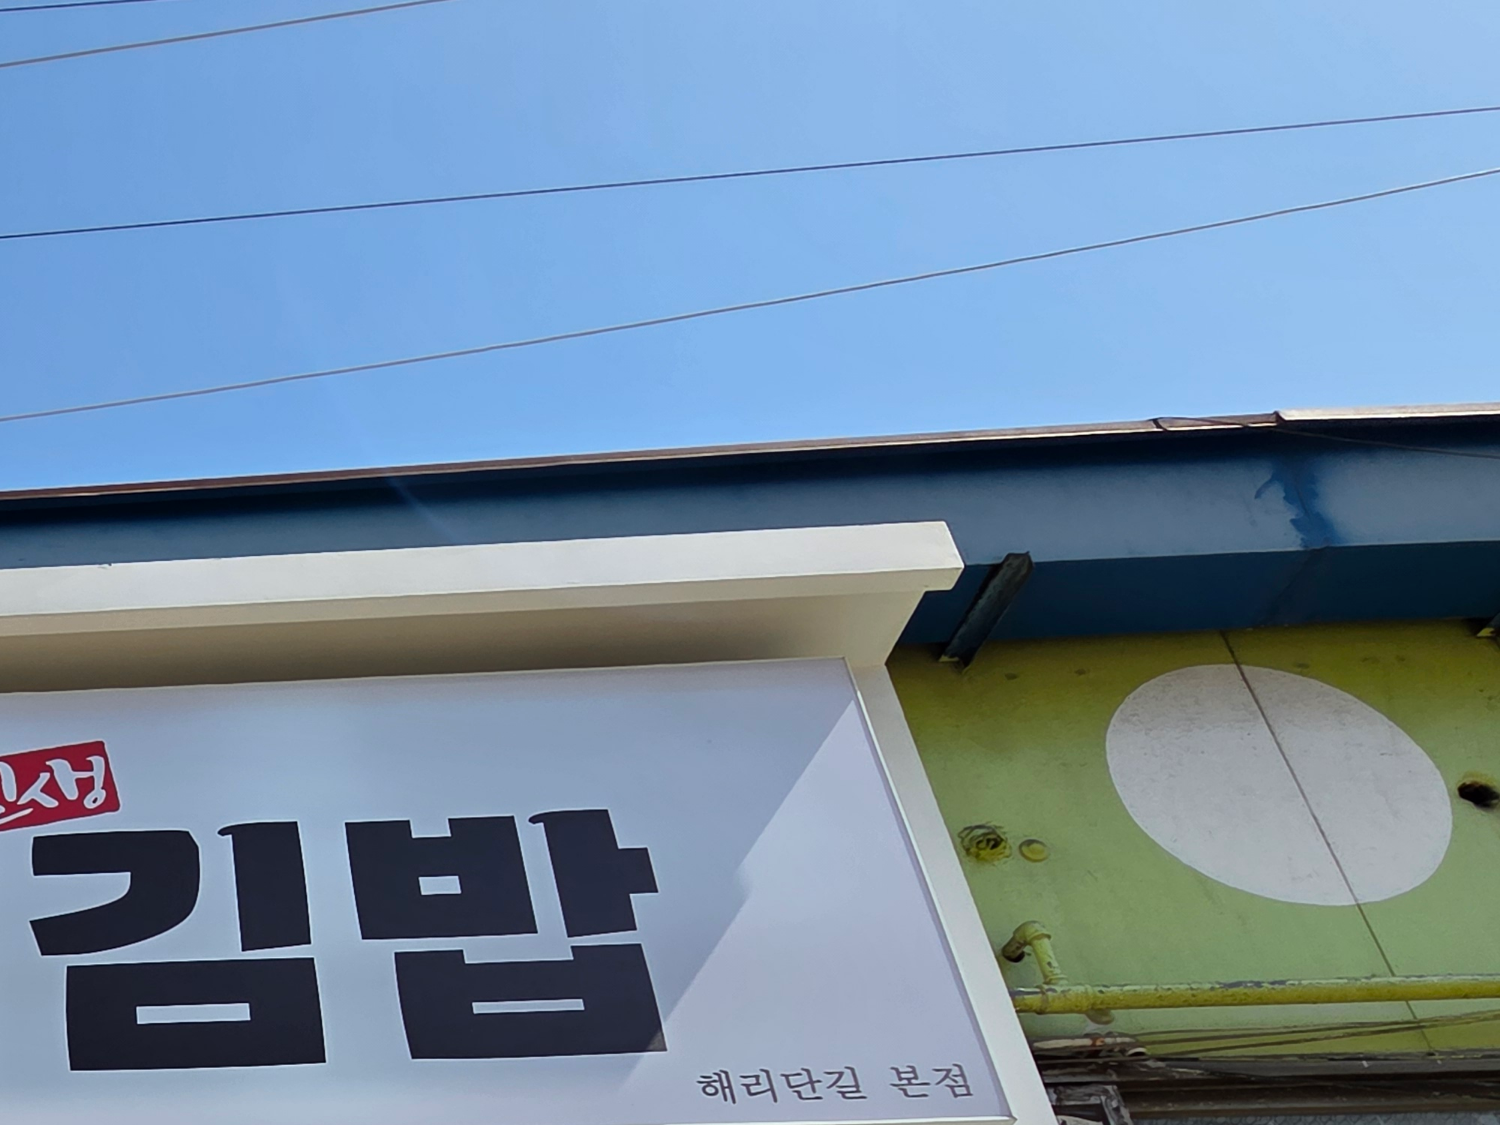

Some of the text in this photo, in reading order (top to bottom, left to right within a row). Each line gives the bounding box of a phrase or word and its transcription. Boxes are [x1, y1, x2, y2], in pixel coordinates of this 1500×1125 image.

[29, 808, 667, 1071] 김밥
[696, 1063, 973, 1104] 해리단길 본점
